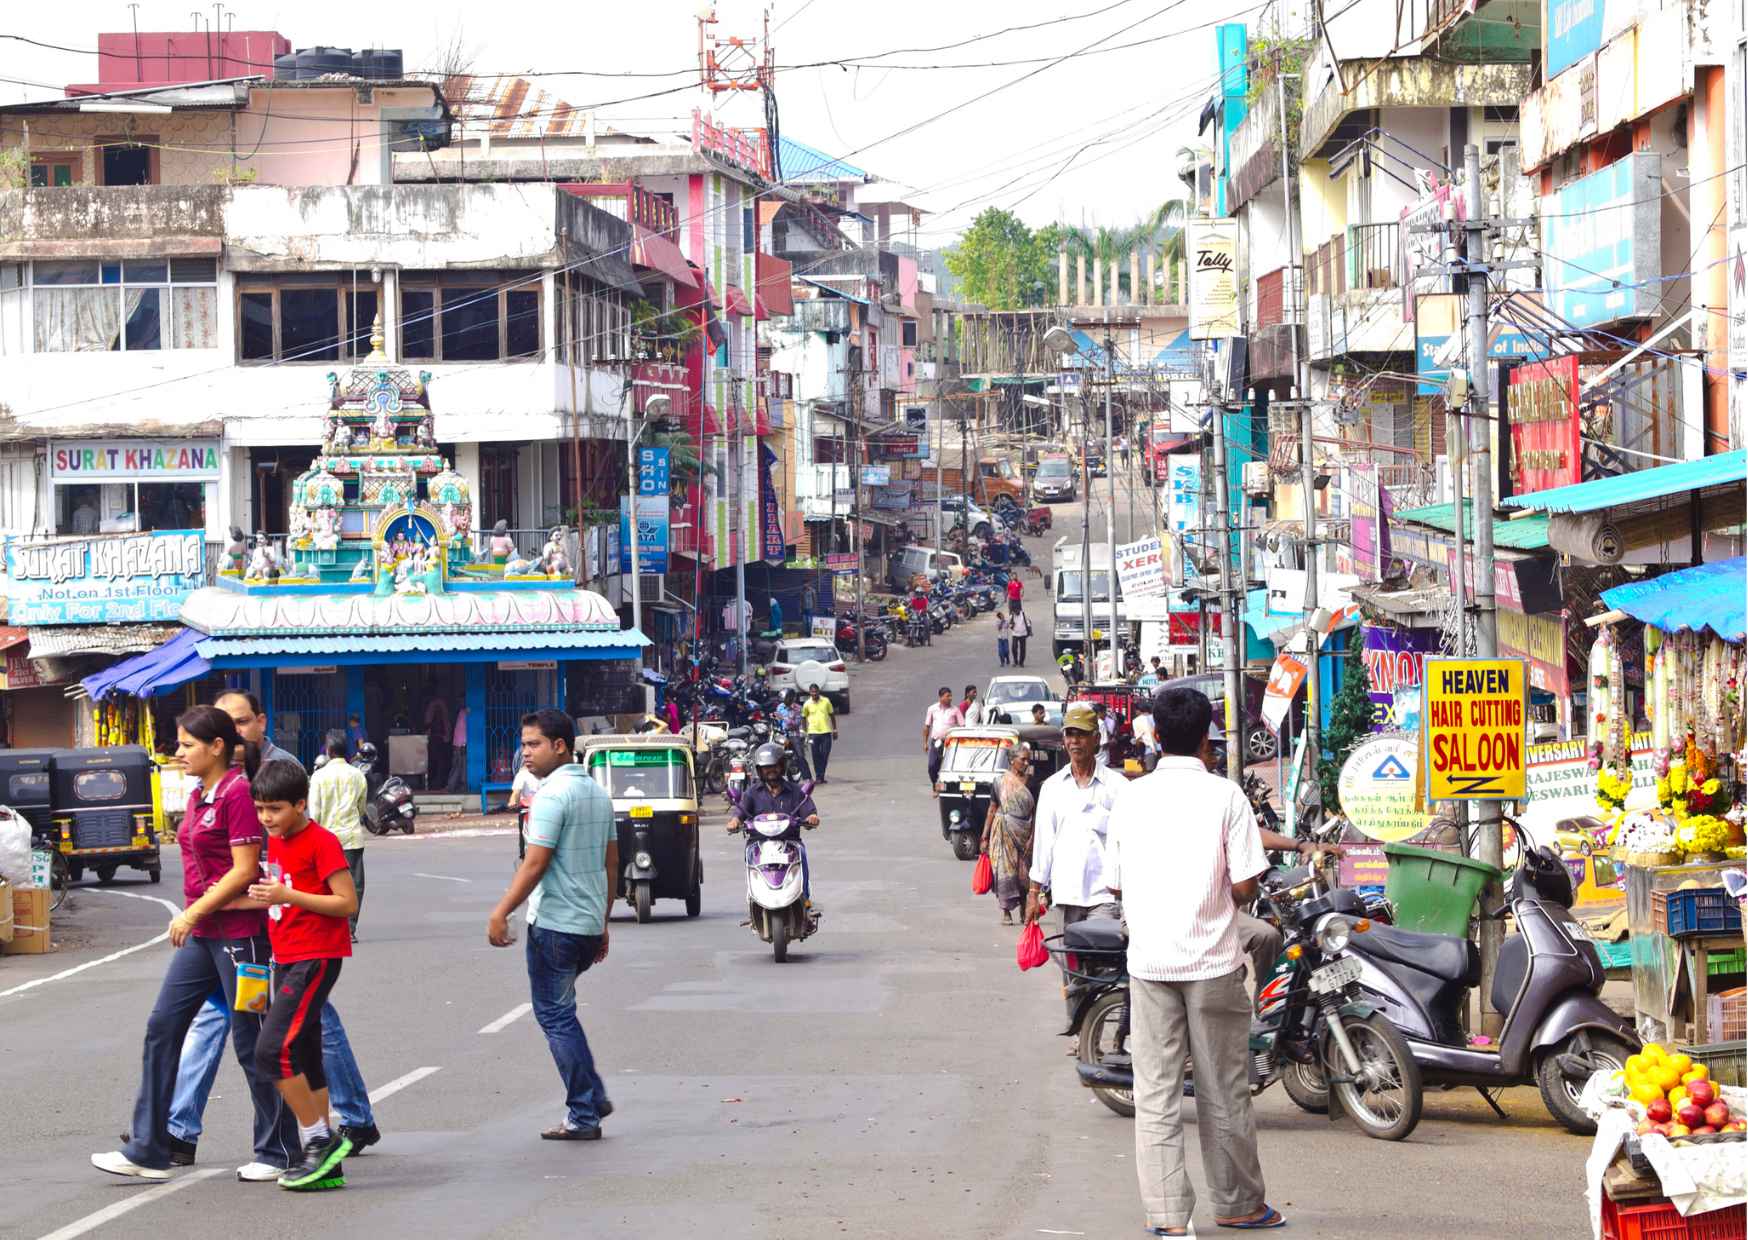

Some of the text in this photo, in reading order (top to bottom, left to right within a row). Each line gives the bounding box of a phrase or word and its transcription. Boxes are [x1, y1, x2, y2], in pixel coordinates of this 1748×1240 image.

[1197, 250, 1233, 273] Tally
[56, 448, 218, 471] SURAT KHAZANA
[1116, 541, 1162, 560] STUDE
[136, 584, 179, 597] Floor
[1442, 669, 1509, 694] HEAVEN
[1431, 701, 1463, 727] HAIR
[1471, 700, 1521, 726] CUTTING
[1433, 732, 1520, 772] SALOON
[1531, 785, 1589, 801] ESWARI
